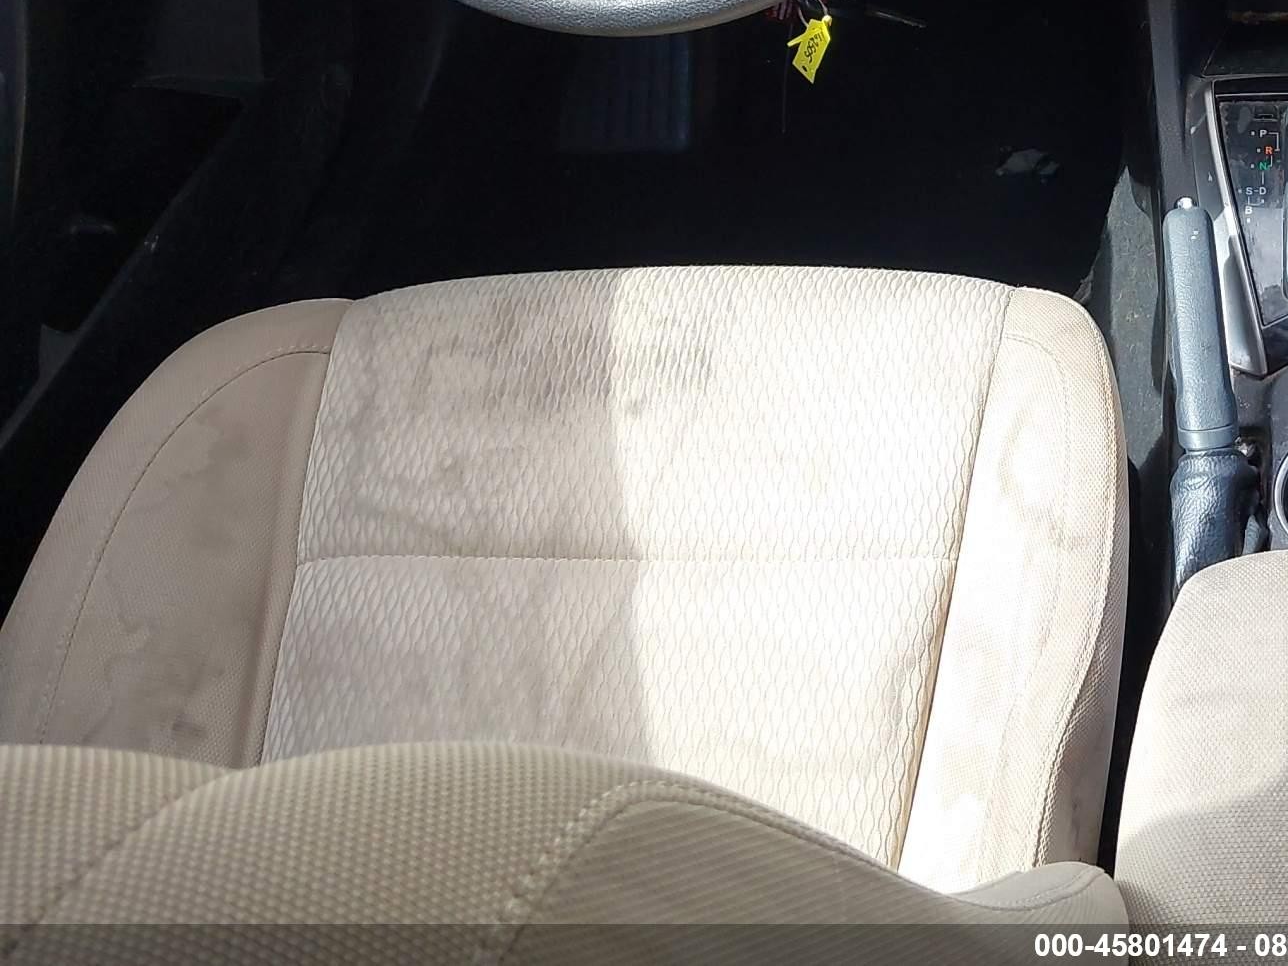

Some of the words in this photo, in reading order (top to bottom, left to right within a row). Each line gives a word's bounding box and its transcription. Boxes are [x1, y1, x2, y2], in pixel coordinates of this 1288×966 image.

[1259, 129, 1268, 138] P
[1265, 146, 1273, 155] R
[1259, 161, 1268, 171] N
[1245, 206, 1253, 215] B
